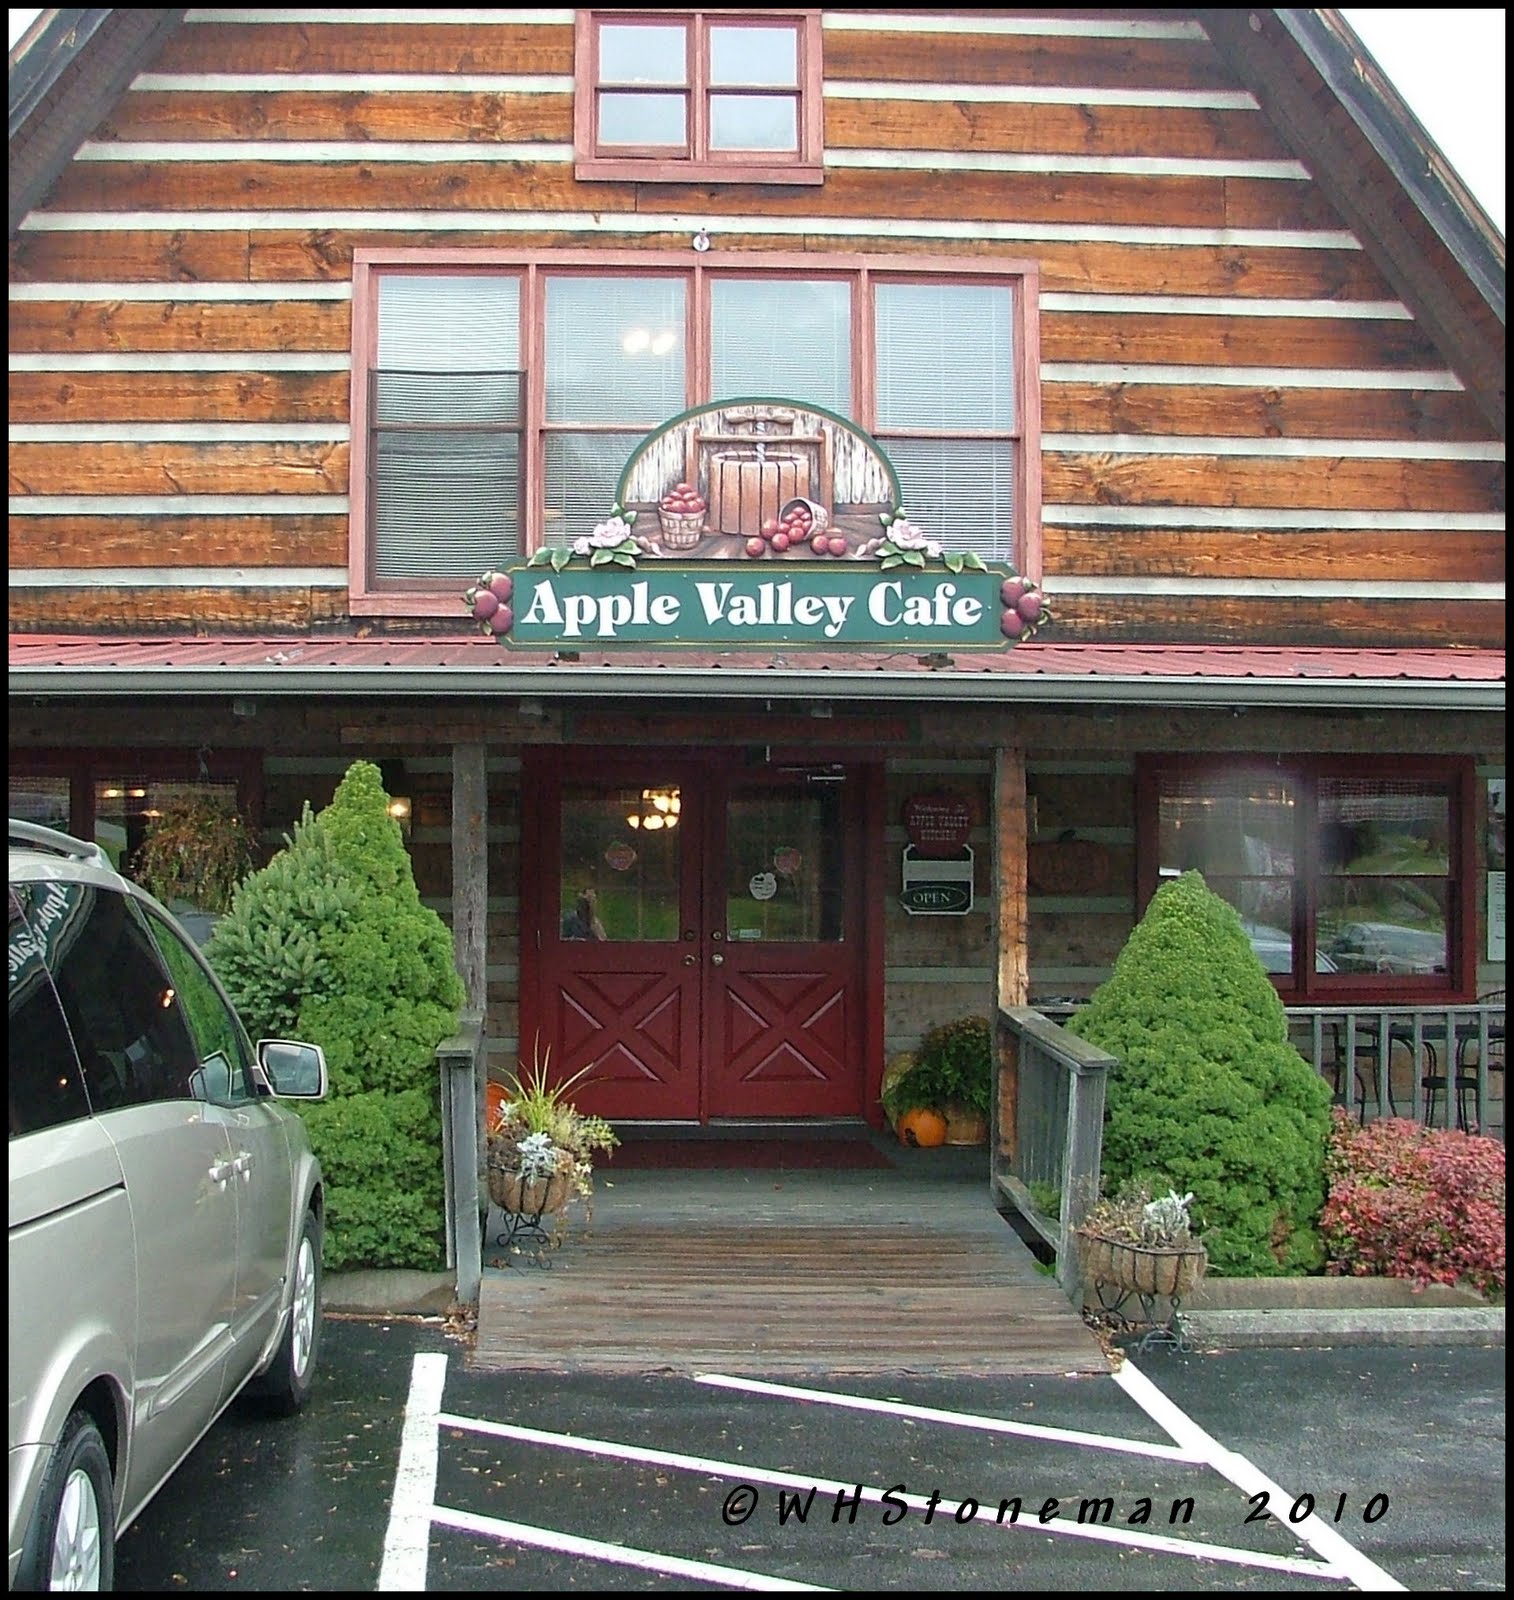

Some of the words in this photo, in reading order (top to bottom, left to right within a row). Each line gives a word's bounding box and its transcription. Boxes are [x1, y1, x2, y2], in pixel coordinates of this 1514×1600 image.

[520, 579, 681, 637] Apple
[695, 582, 855, 638] Valley
[868, 581, 983, 627] Cafe
[912, 892, 951, 904] OPEN
